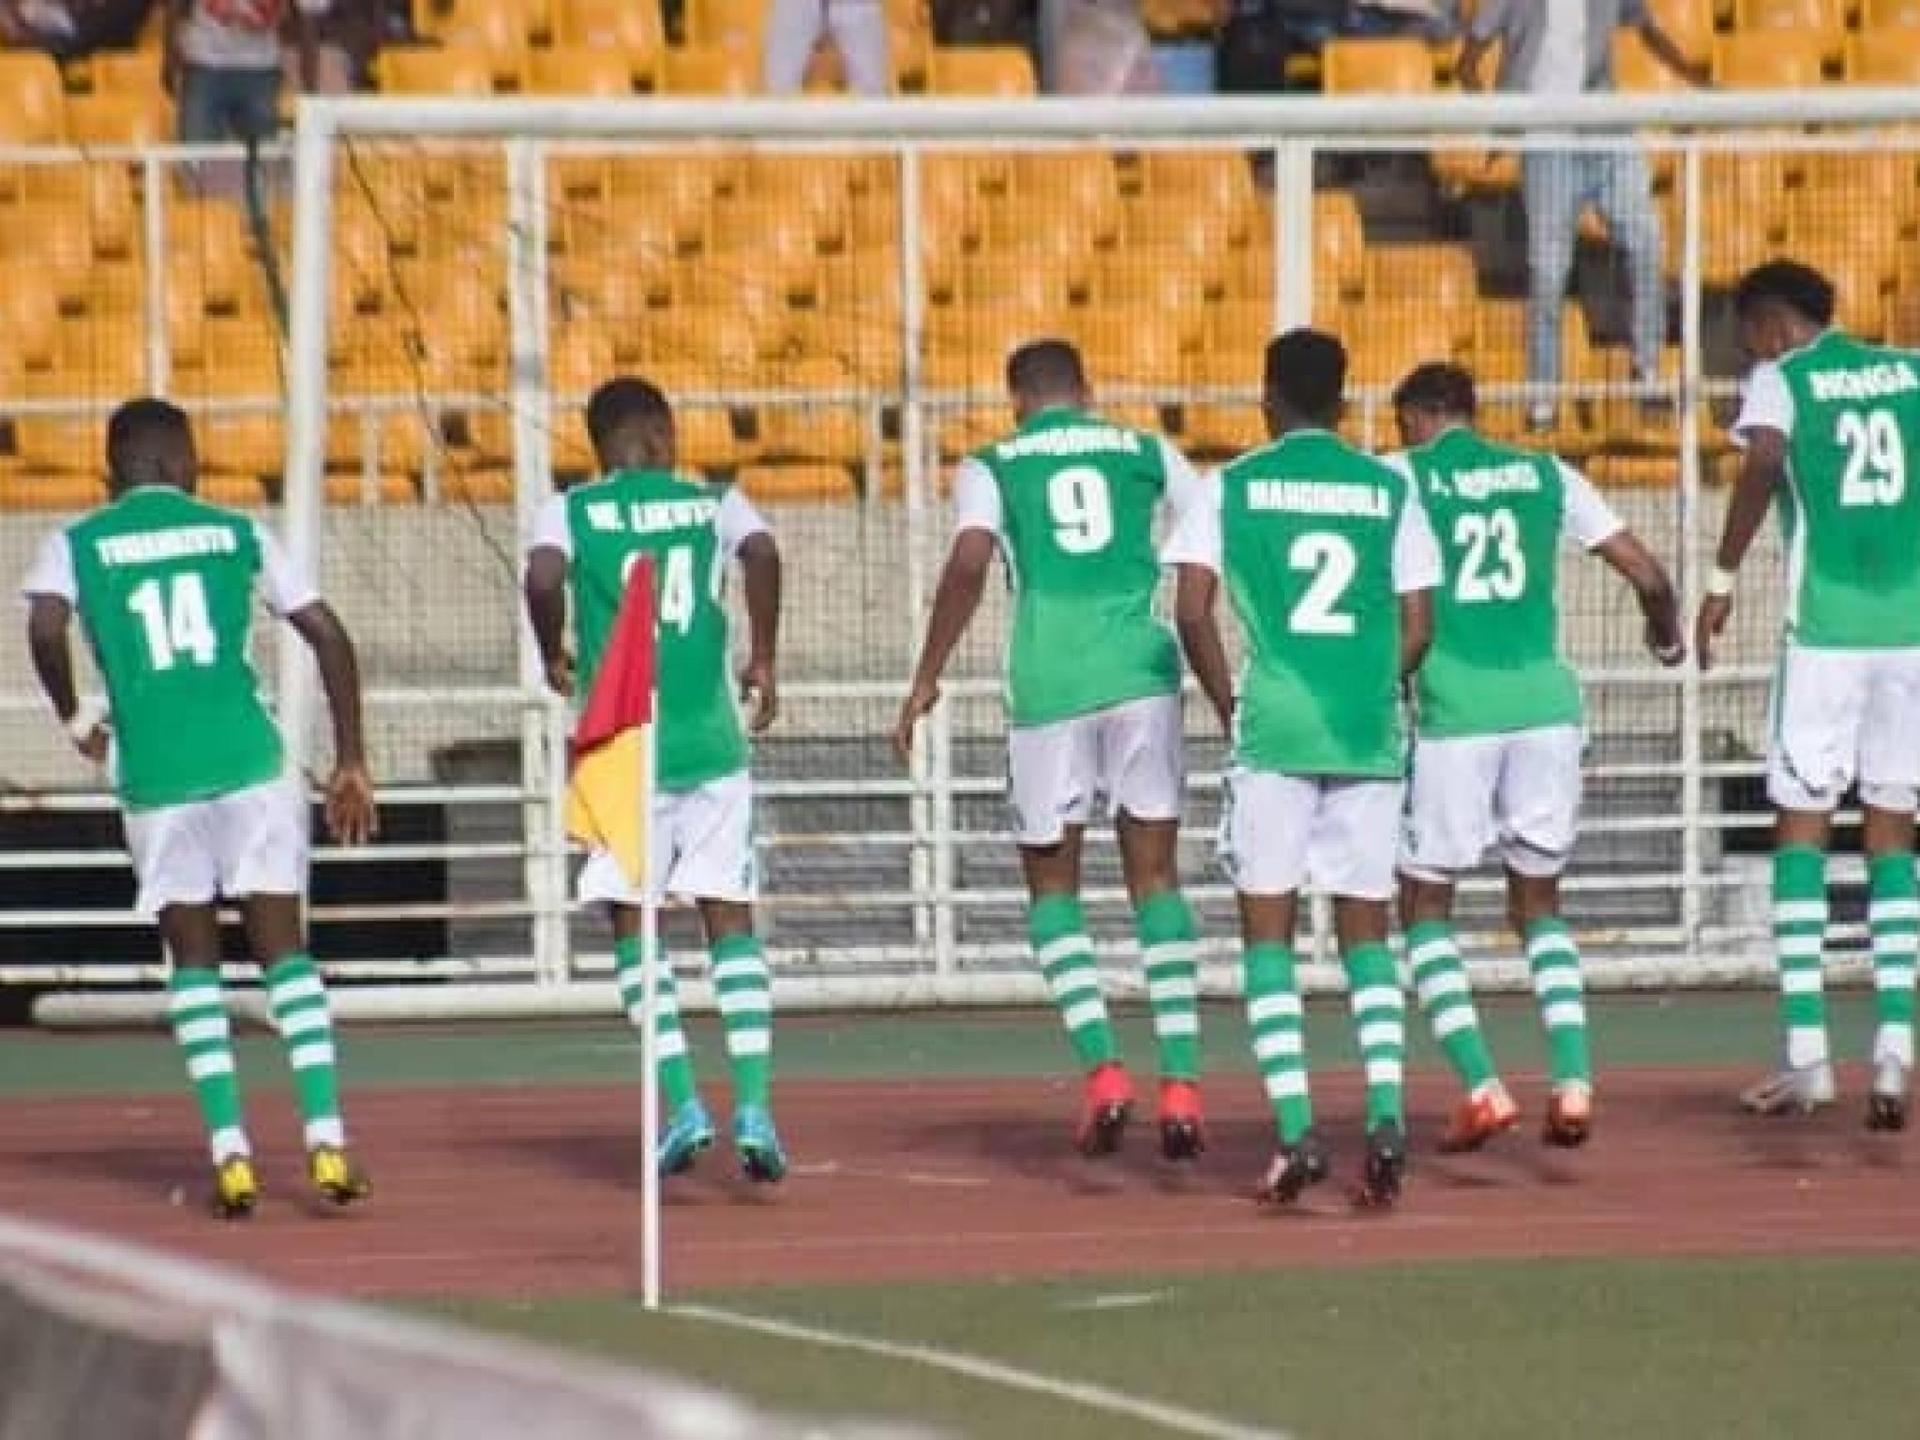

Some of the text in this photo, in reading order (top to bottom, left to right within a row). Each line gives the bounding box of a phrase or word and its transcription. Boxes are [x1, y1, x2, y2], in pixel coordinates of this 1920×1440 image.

[1837, 408, 1905, 507] 29
[1047, 465, 1114, 554] 9
[1454, 508, 1527, 603] 23
[126, 571, 217, 671] 14
[1288, 530, 1357, 635] 2
